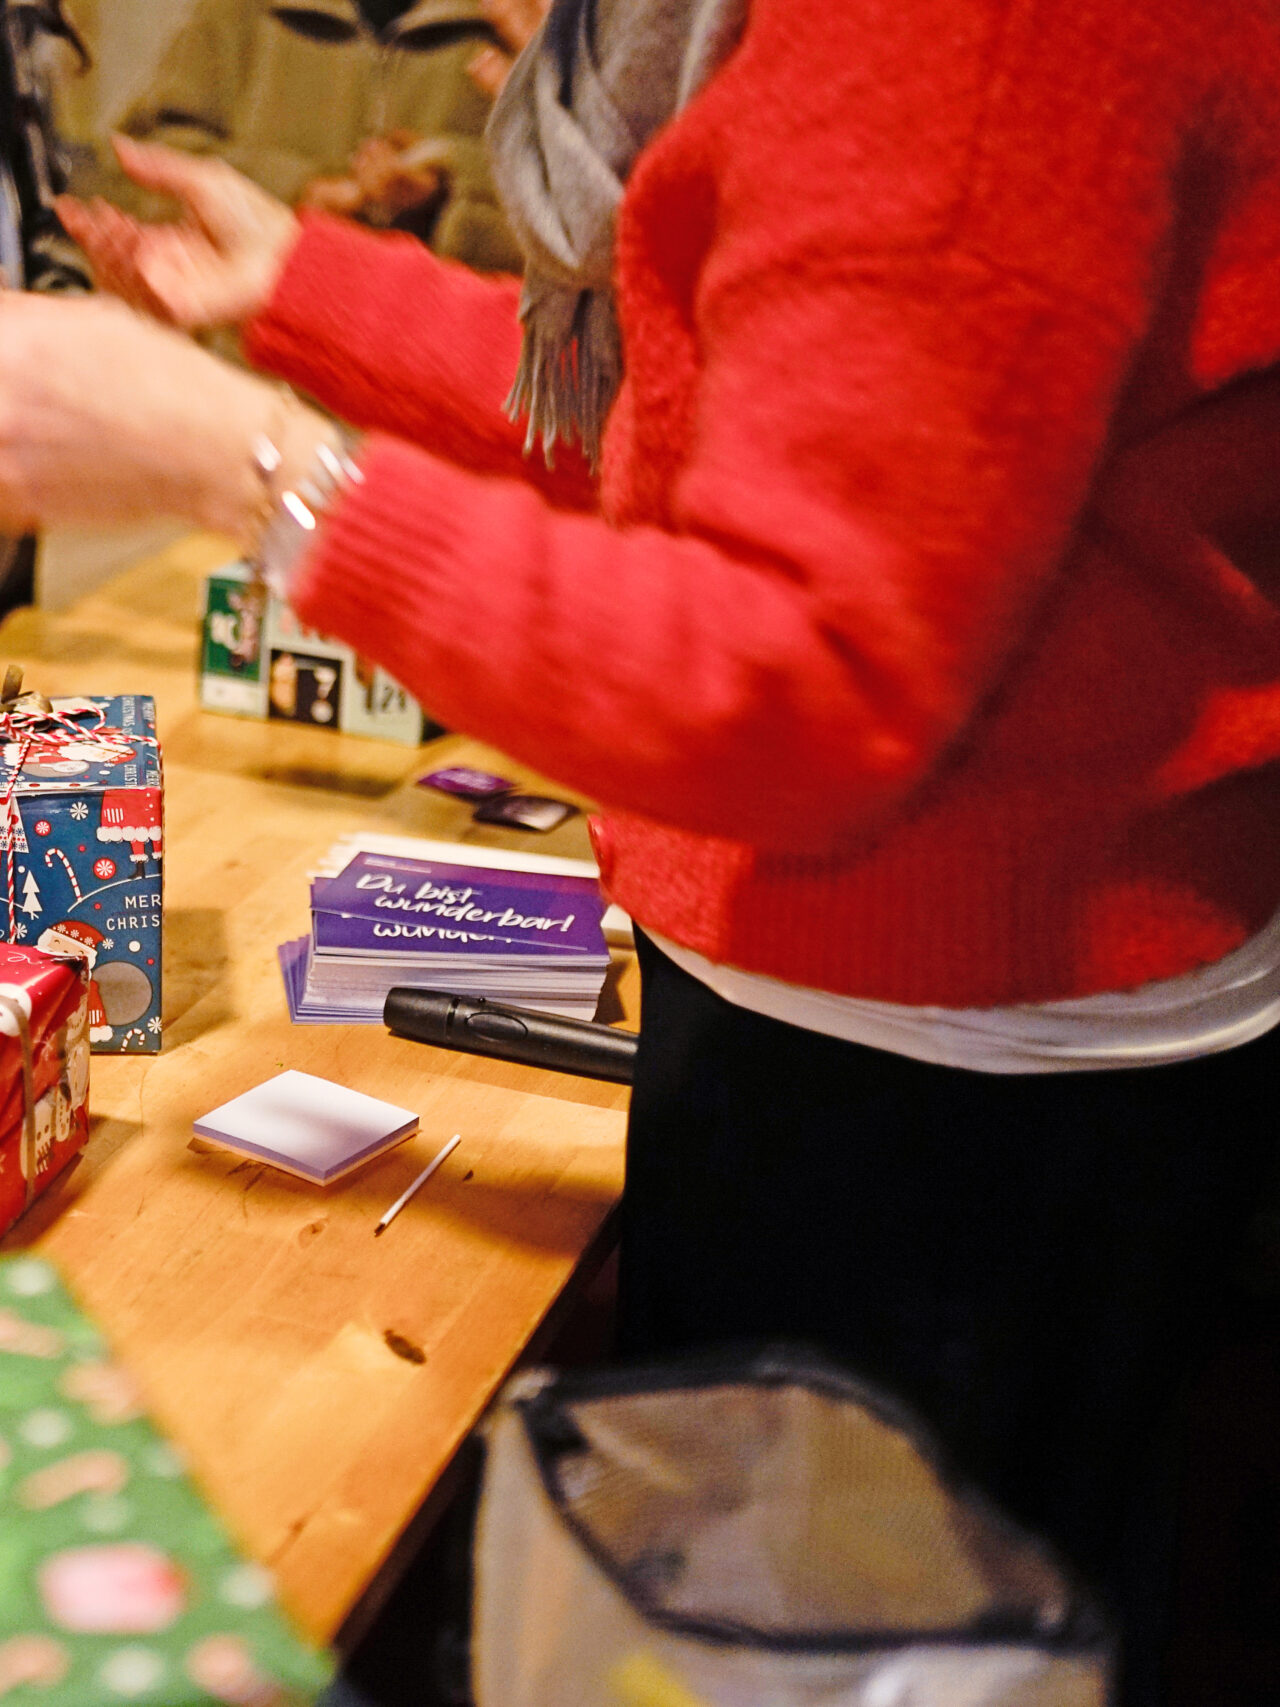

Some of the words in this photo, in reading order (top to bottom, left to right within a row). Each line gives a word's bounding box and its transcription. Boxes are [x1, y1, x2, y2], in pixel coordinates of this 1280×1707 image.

[356, 873, 407, 894] Du
[414, 881, 484, 904] bist
[125, 894, 162, 909] MER
[374, 894, 575, 932] wunderbar!
[106, 914, 160, 931] CHRIS
